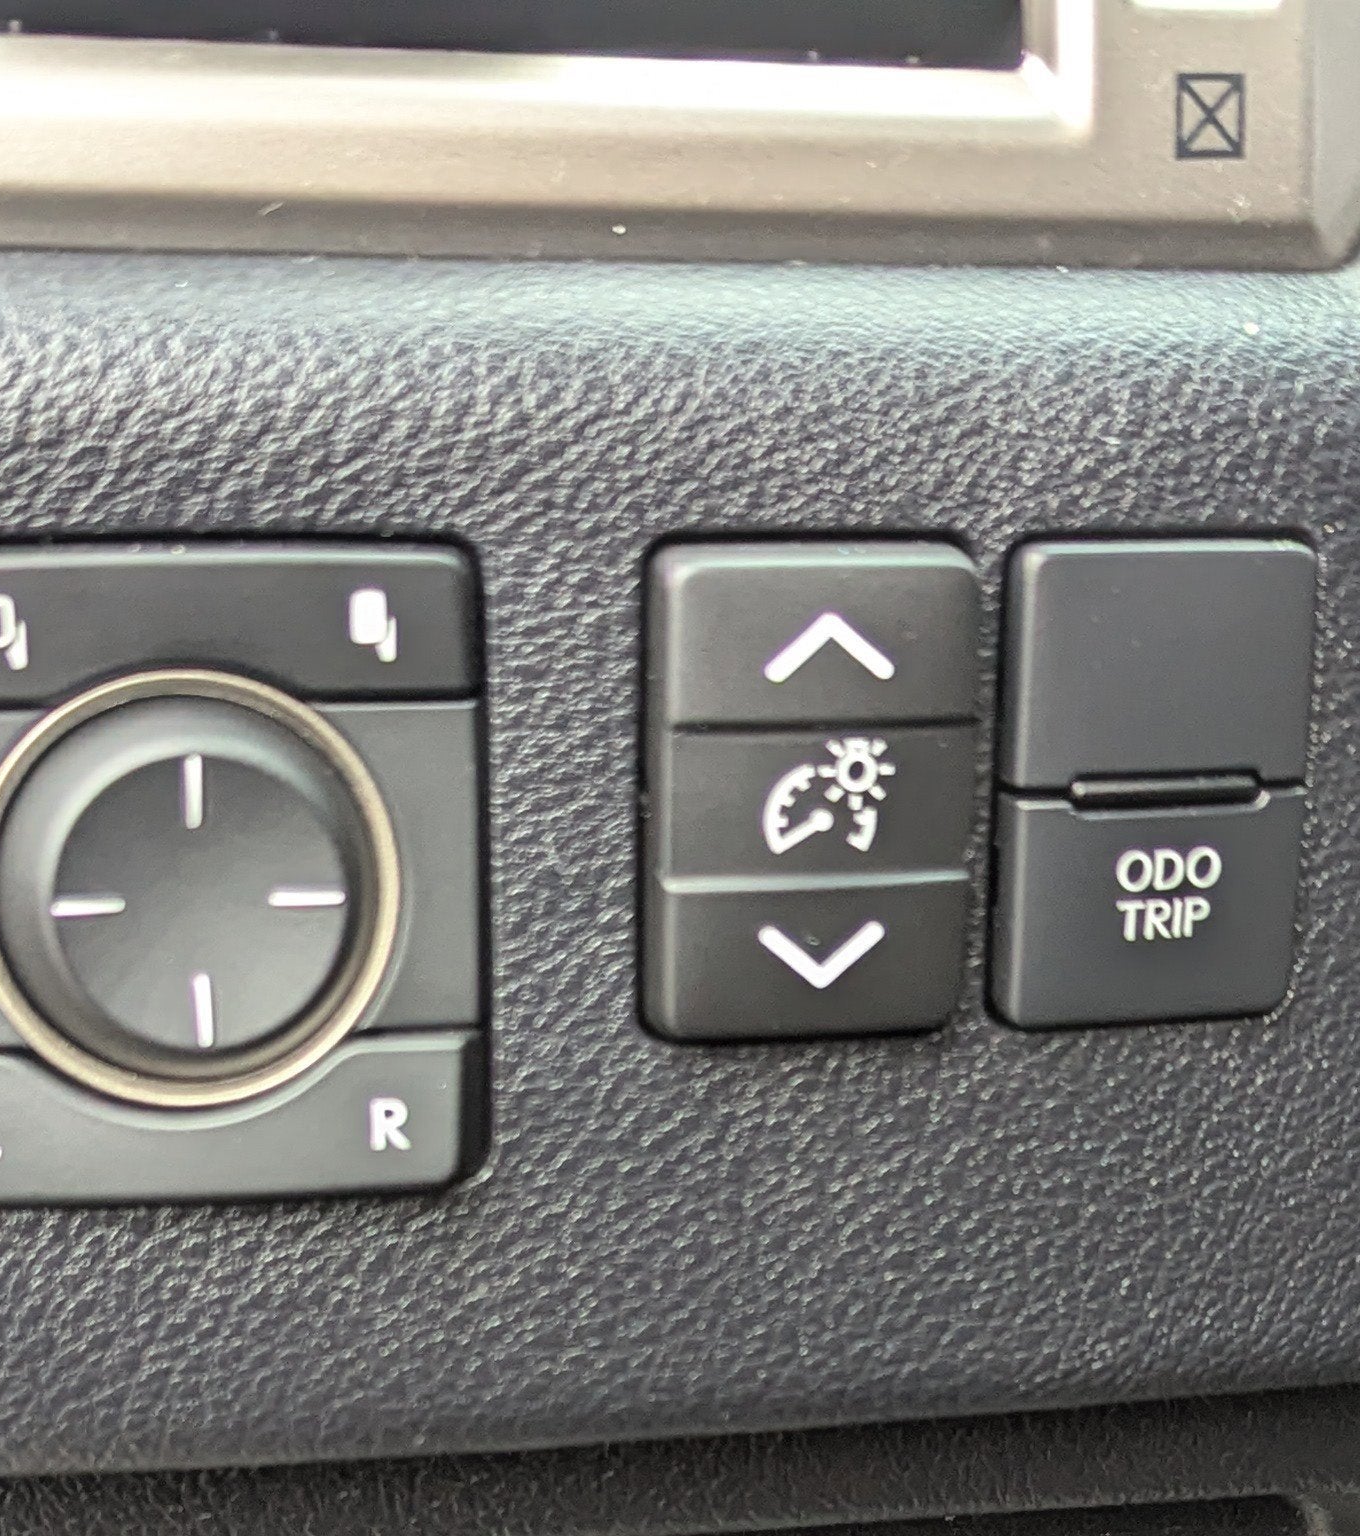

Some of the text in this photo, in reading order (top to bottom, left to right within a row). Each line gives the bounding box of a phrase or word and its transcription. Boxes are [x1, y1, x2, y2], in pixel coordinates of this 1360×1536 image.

[1116, 846, 1222, 894] ODO
[1116, 896, 1211, 941] TRIP
[369, 1098, 411, 1151] R
